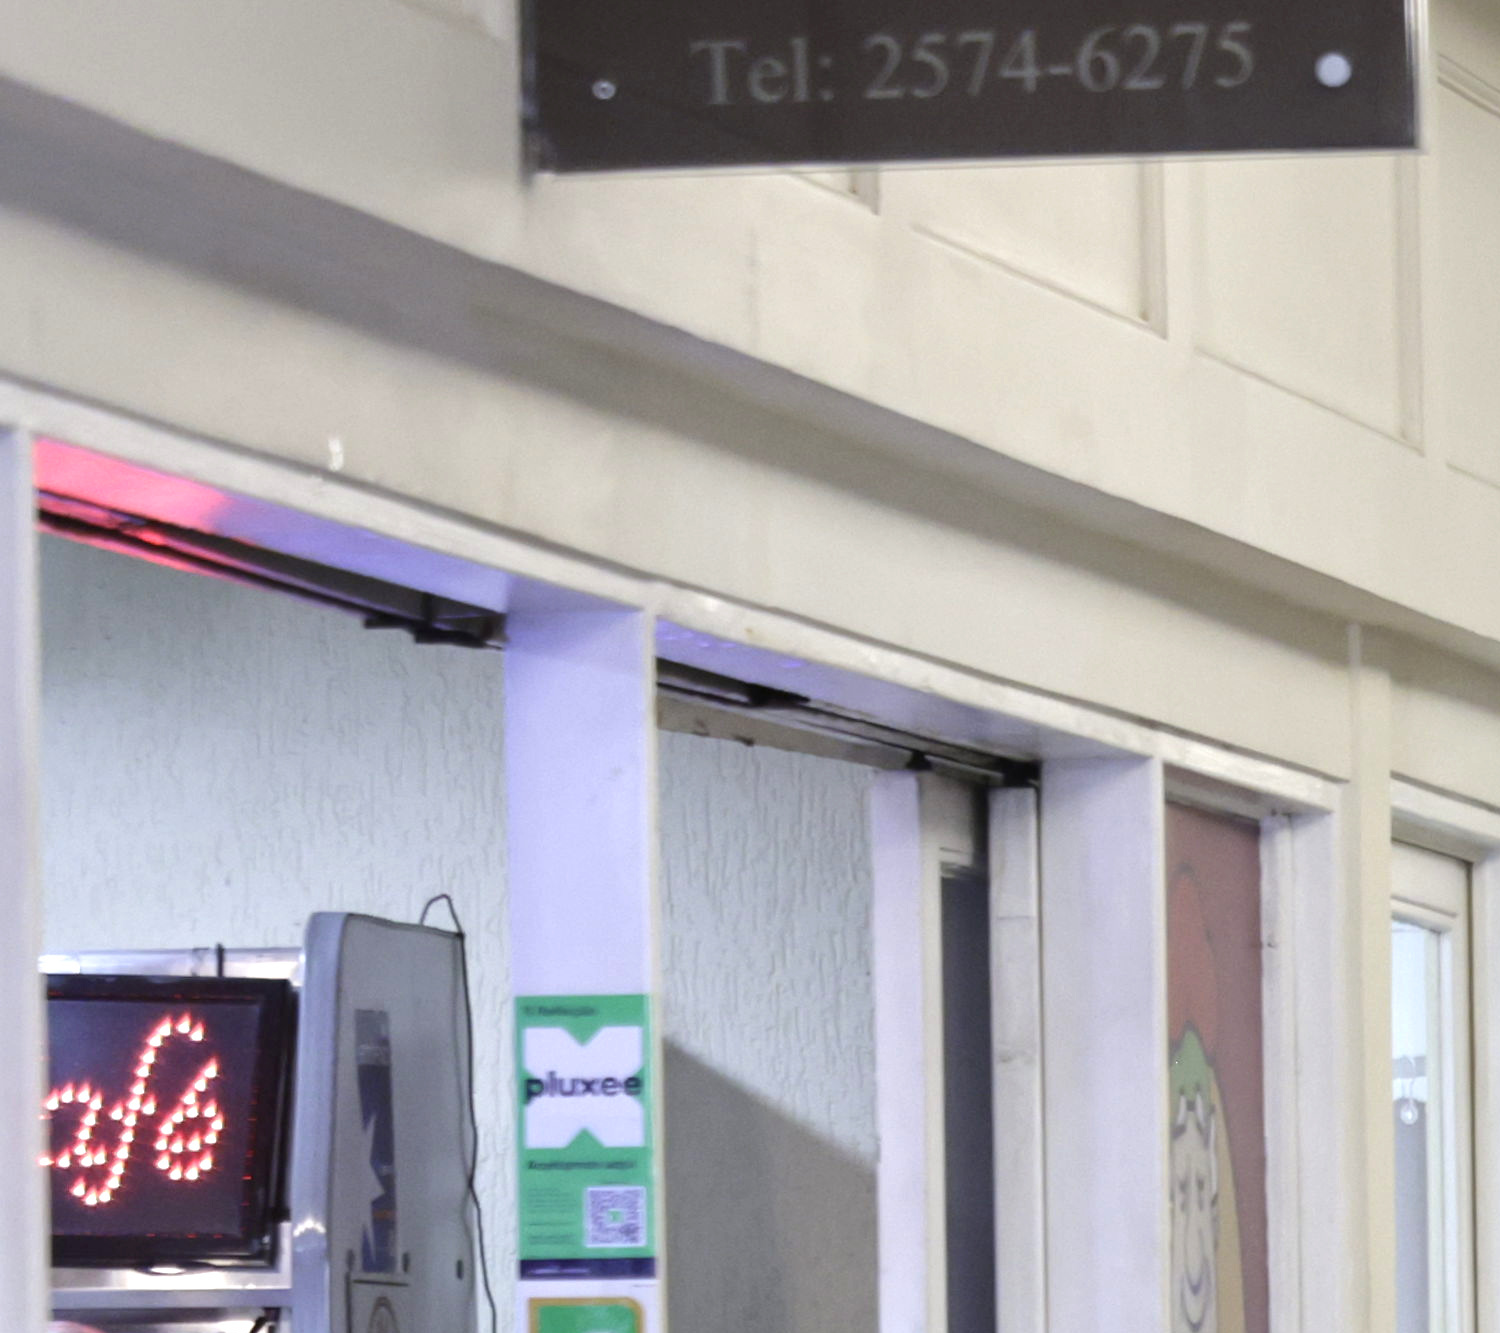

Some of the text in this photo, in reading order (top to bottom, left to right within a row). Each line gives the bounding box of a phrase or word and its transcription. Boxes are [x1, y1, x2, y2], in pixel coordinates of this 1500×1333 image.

[690, 22, 1257, 106] Tel: 2574-6275
[523, 1070, 643, 1106] pluxee
